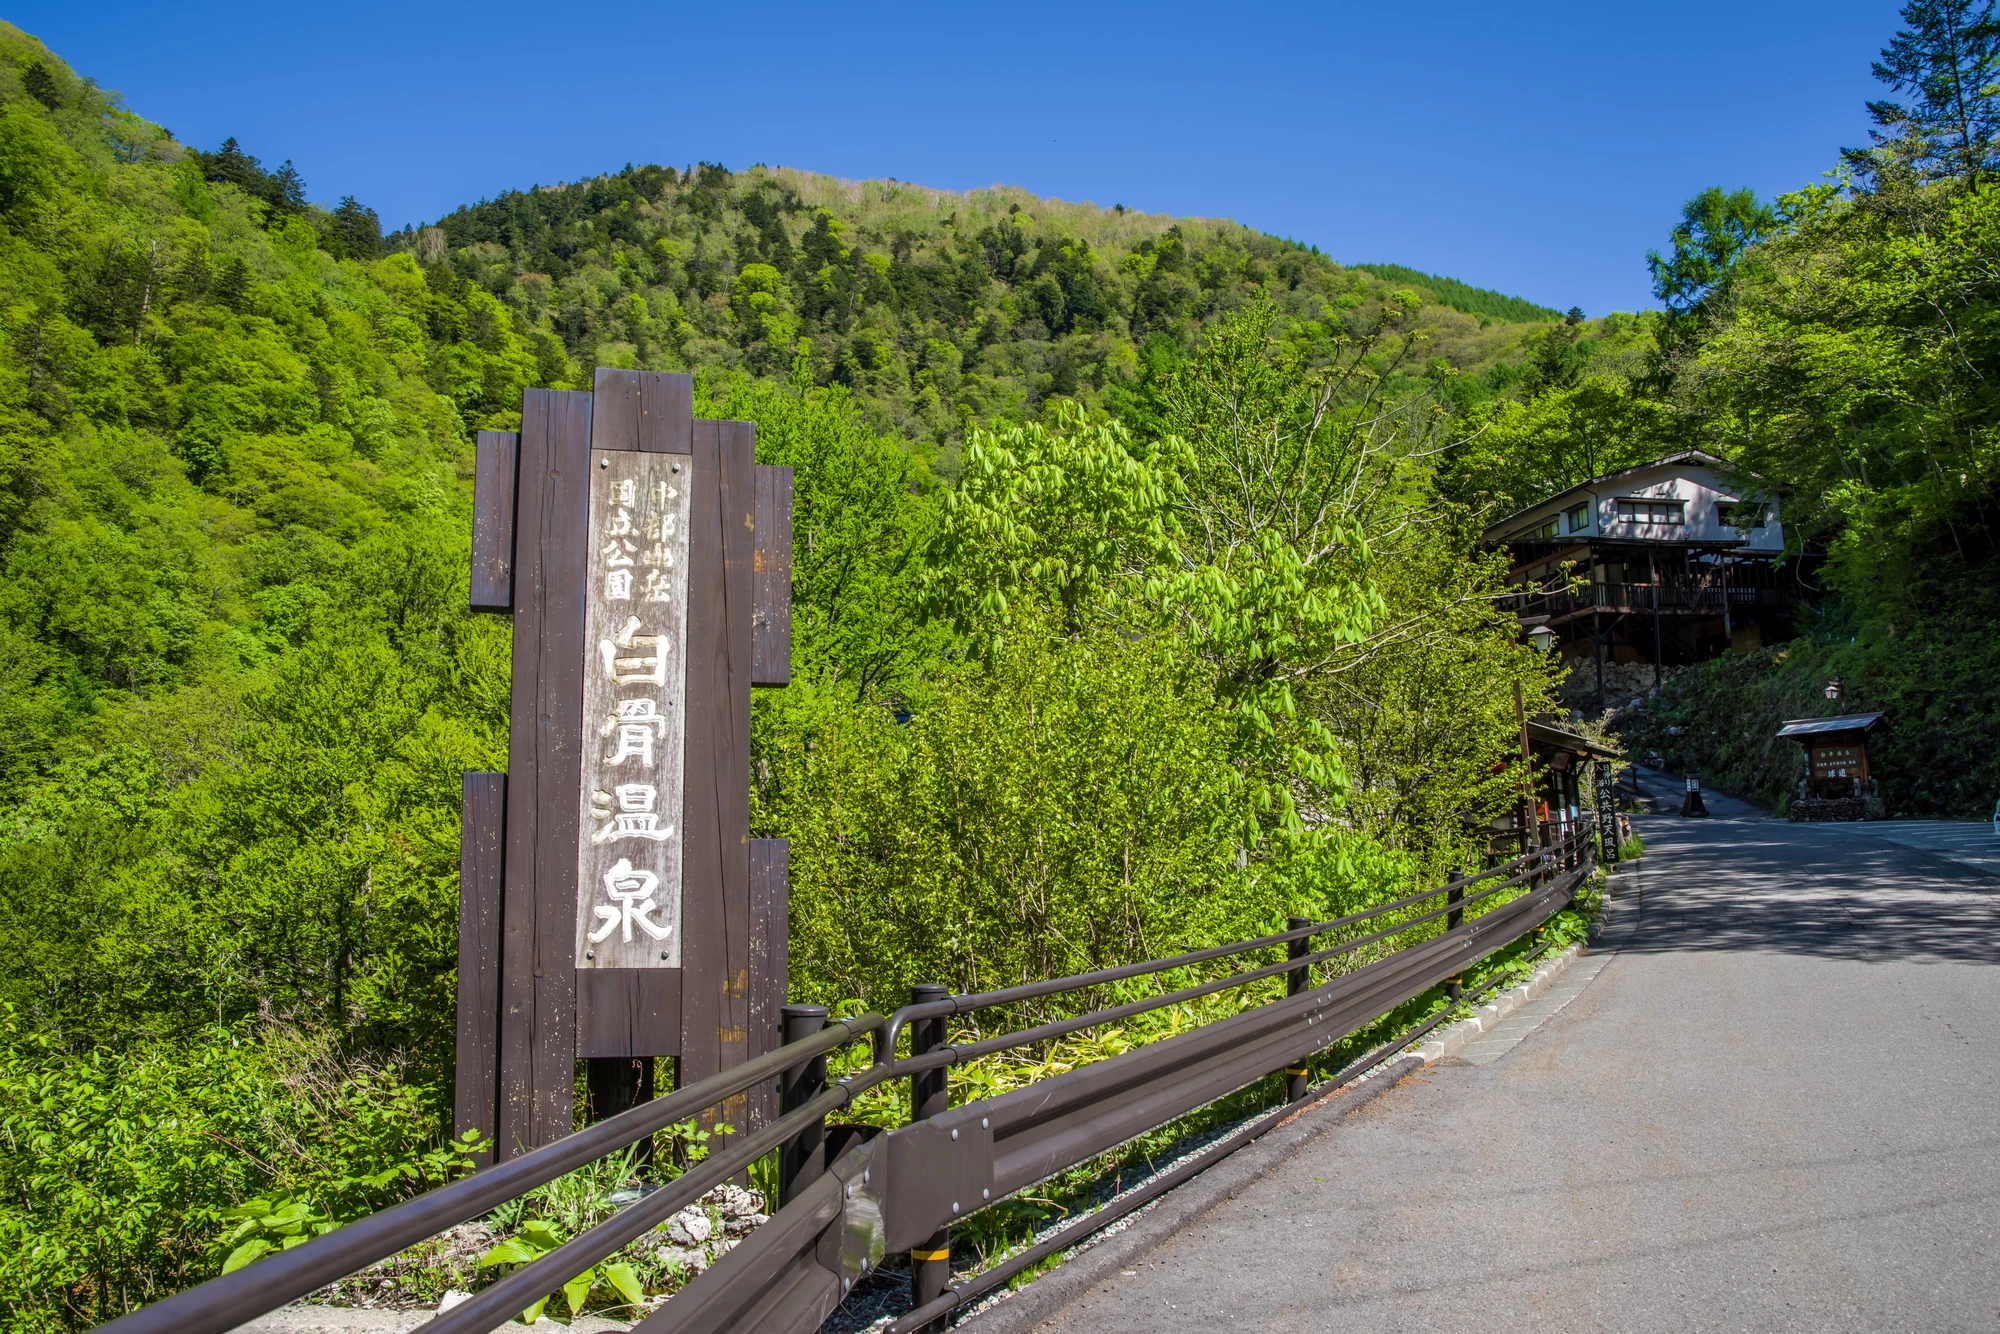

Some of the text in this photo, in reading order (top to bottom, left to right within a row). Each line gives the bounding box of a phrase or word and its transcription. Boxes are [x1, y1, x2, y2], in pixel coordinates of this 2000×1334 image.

[602, 479, 640, 601] 国立公園
[640, 480, 679, 602] 中部山岳
[587, 614, 674, 943] 白骨温泉
[1600, 789, 1616, 859] 公共野天風呂
